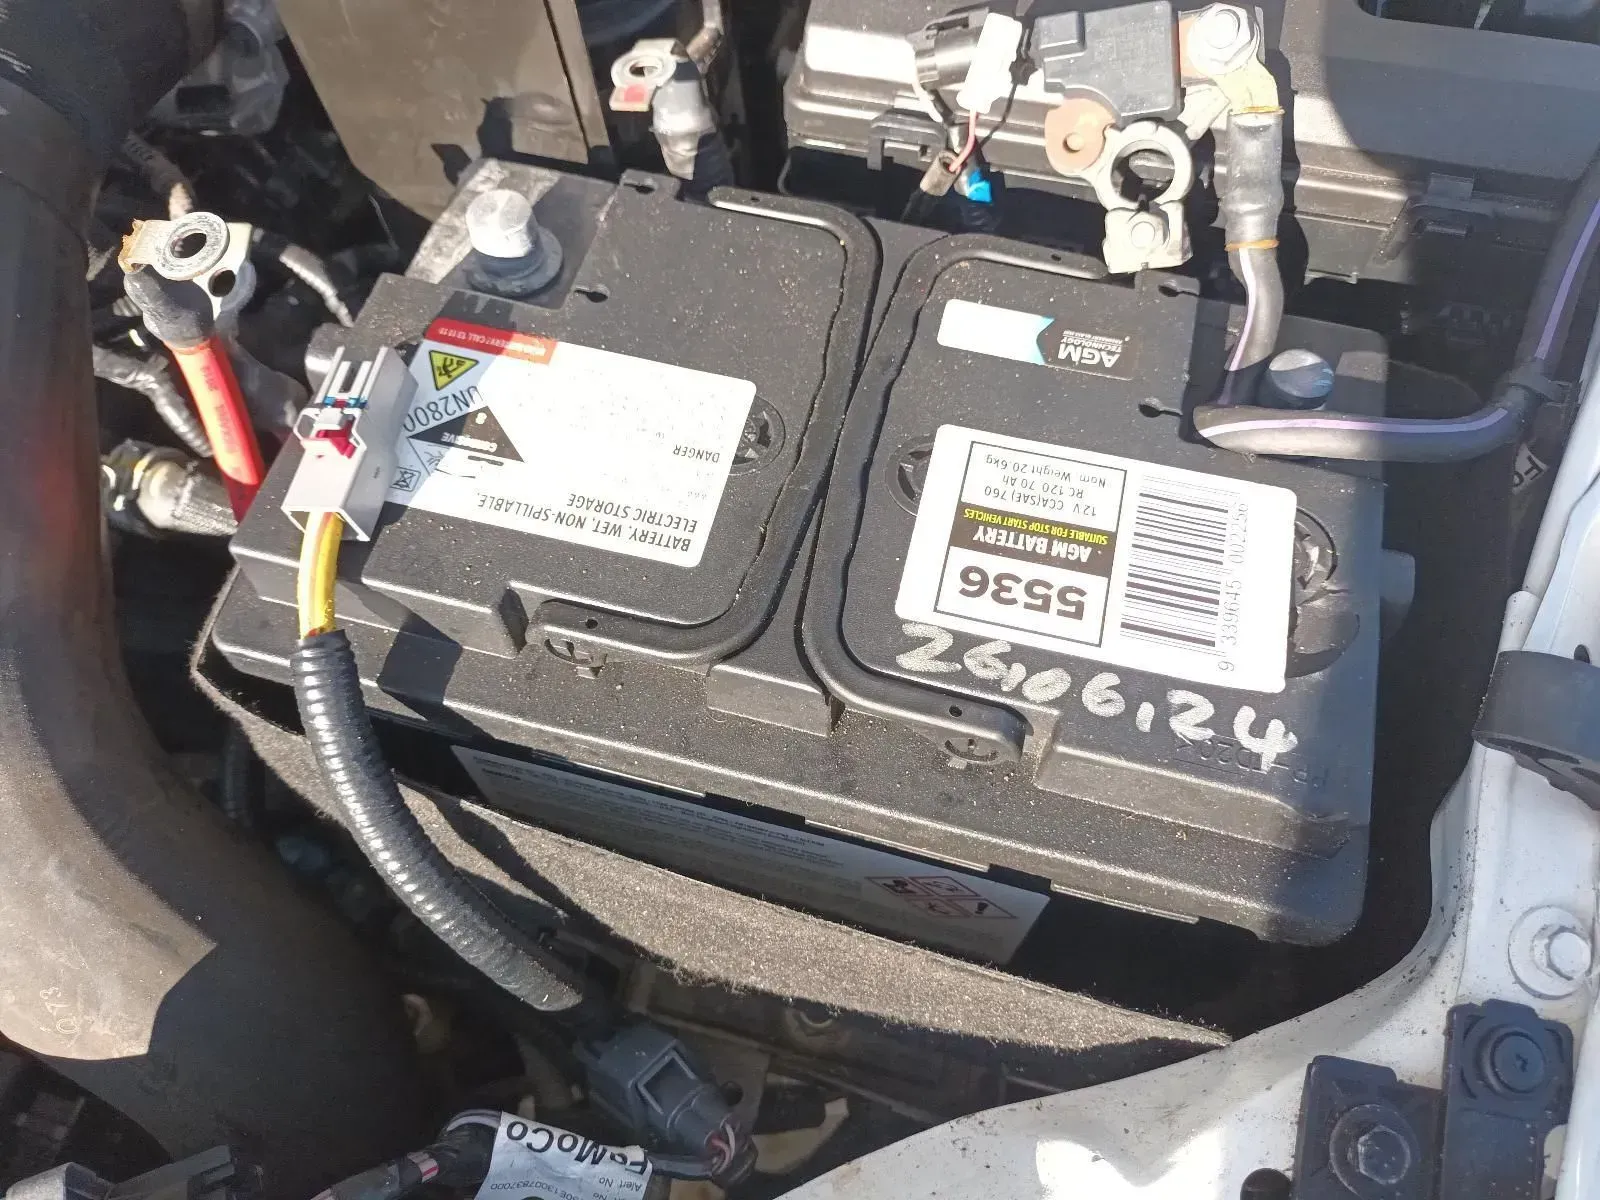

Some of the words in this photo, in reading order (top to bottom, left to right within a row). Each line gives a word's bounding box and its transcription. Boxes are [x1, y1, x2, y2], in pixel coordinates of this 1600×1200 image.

[1061, 337, 1122, 352] TECHNOLOGY
[1058, 343, 1120, 368] AGM
[673, 444, 720, 463] DANGER
[1030, 465, 1071, 482] Weight
[984, 485, 1007, 500] 760
[1042, 483, 1064, 496] 120
[1070, 488, 1084, 499] RC
[567, 493, 631, 518] STORAGE
[633, 508, 698, 533] ELECTRIC
[963, 508, 1003, 526] VEHICLES
[1002, 517, 1029, 531] START
[1027, 521, 1050, 535] STOP
[1050, 526, 1069, 538] FOR
[973, 525, 1049, 557] BATTERY
[1070, 530, 1108, 545] SUITABLE
[1051, 540, 1093, 563] AGM
[958, 565, 1088, 621] 5536
[1220, 579, 1242, 646] 339645
[1217, 660, 1235, 672] 9
[598, 1177, 614, 1188] No
[619, 1180, 643, 1191] Alert
